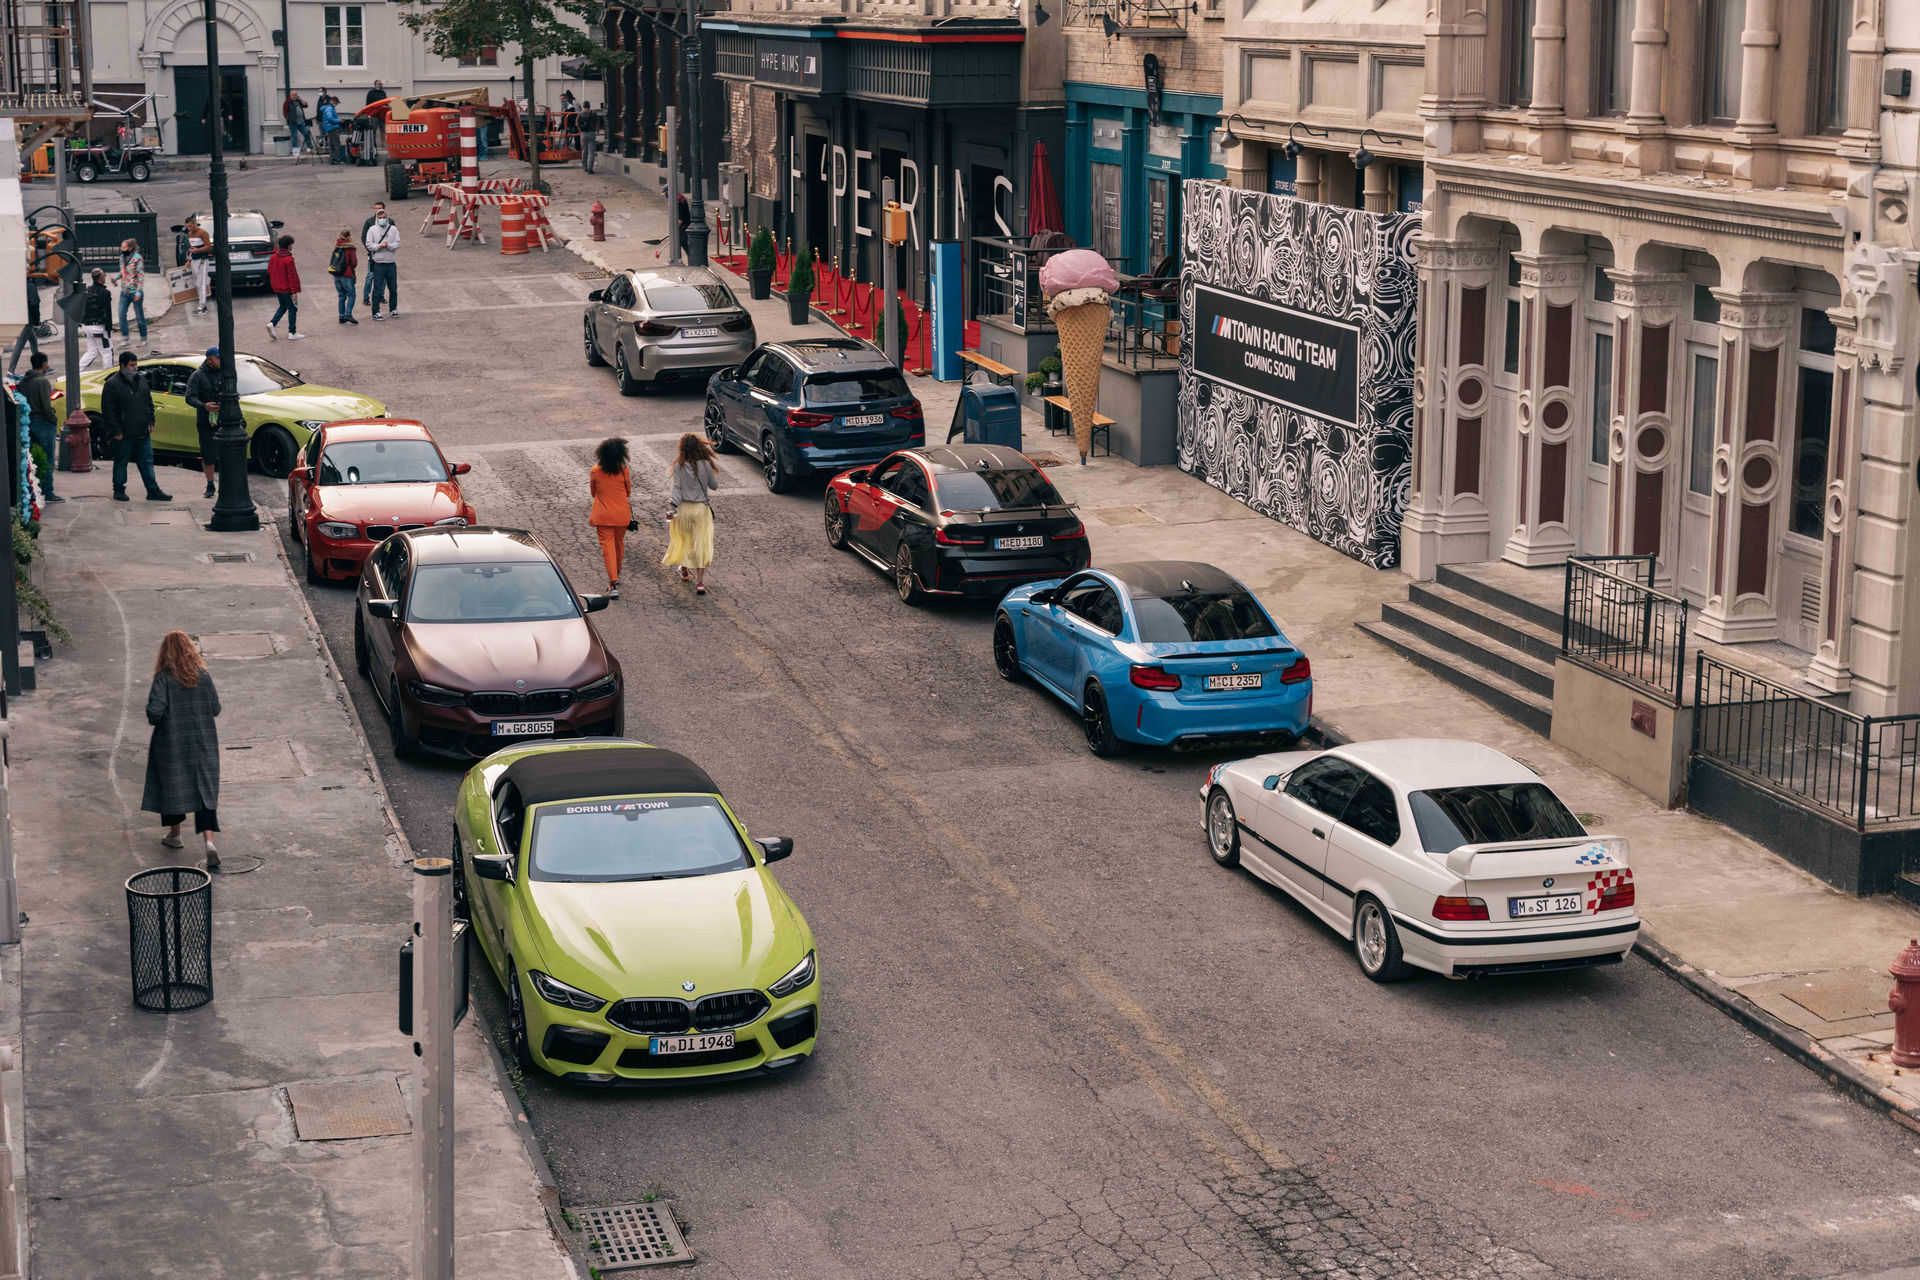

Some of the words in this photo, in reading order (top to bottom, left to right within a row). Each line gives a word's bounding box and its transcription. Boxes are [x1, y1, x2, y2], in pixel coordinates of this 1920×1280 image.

[761, 52, 778, 70] HYPE
[782, 54, 799, 73] RIMS
[1263, 329, 1302, 361] RACING
[1304, 340, 1337, 372] TEAM
[1244, 351, 1273, 374] COMING
[1273, 360, 1296, 382] SOON
[1236, 675, 1260, 686] 2357
[567, 806, 599, 814] BORN
[1536, 899, 1550, 912] ST
[1555, 897, 1577, 911] 126
[678, 1038, 695, 1052] DI
[699, 1034, 733, 1050] 1948
